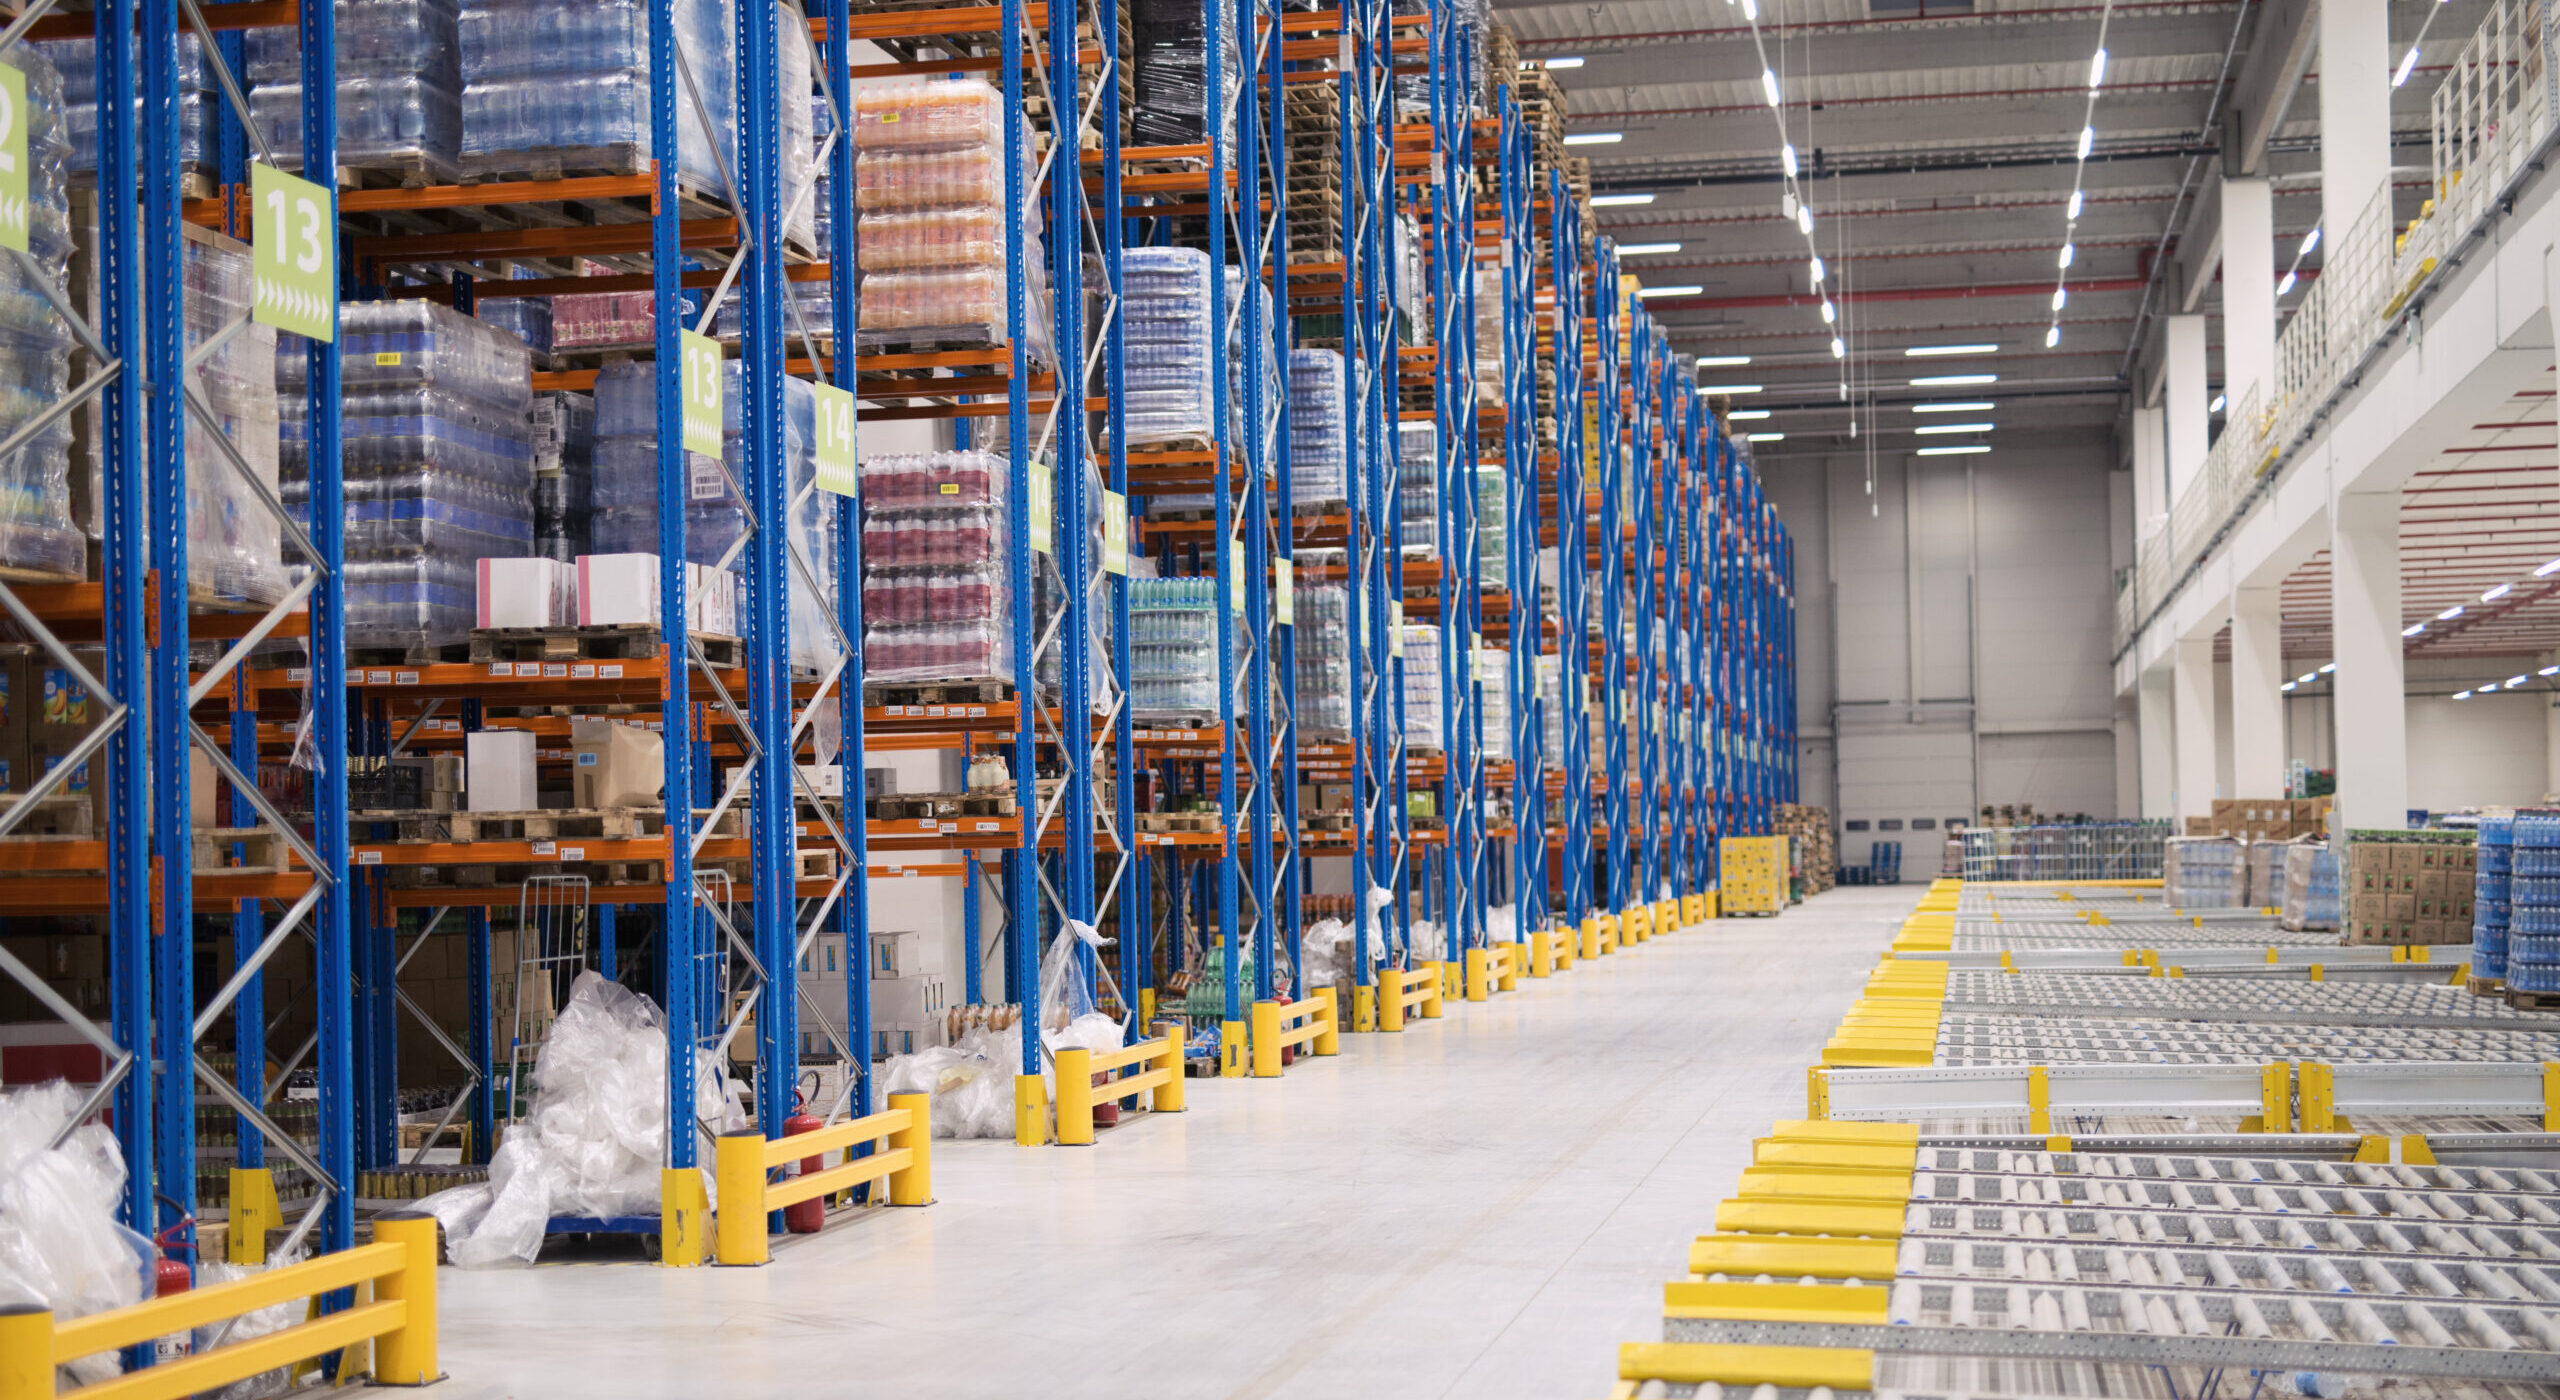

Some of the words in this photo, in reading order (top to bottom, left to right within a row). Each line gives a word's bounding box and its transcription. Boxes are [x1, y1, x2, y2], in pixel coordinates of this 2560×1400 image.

[267, 189, 322, 274] 13
[688, 347, 717, 409] 13
[822, 397, 851, 453] 14
[1032, 473, 1049, 518] 14
[1108, 501, 1124, 542] 15
